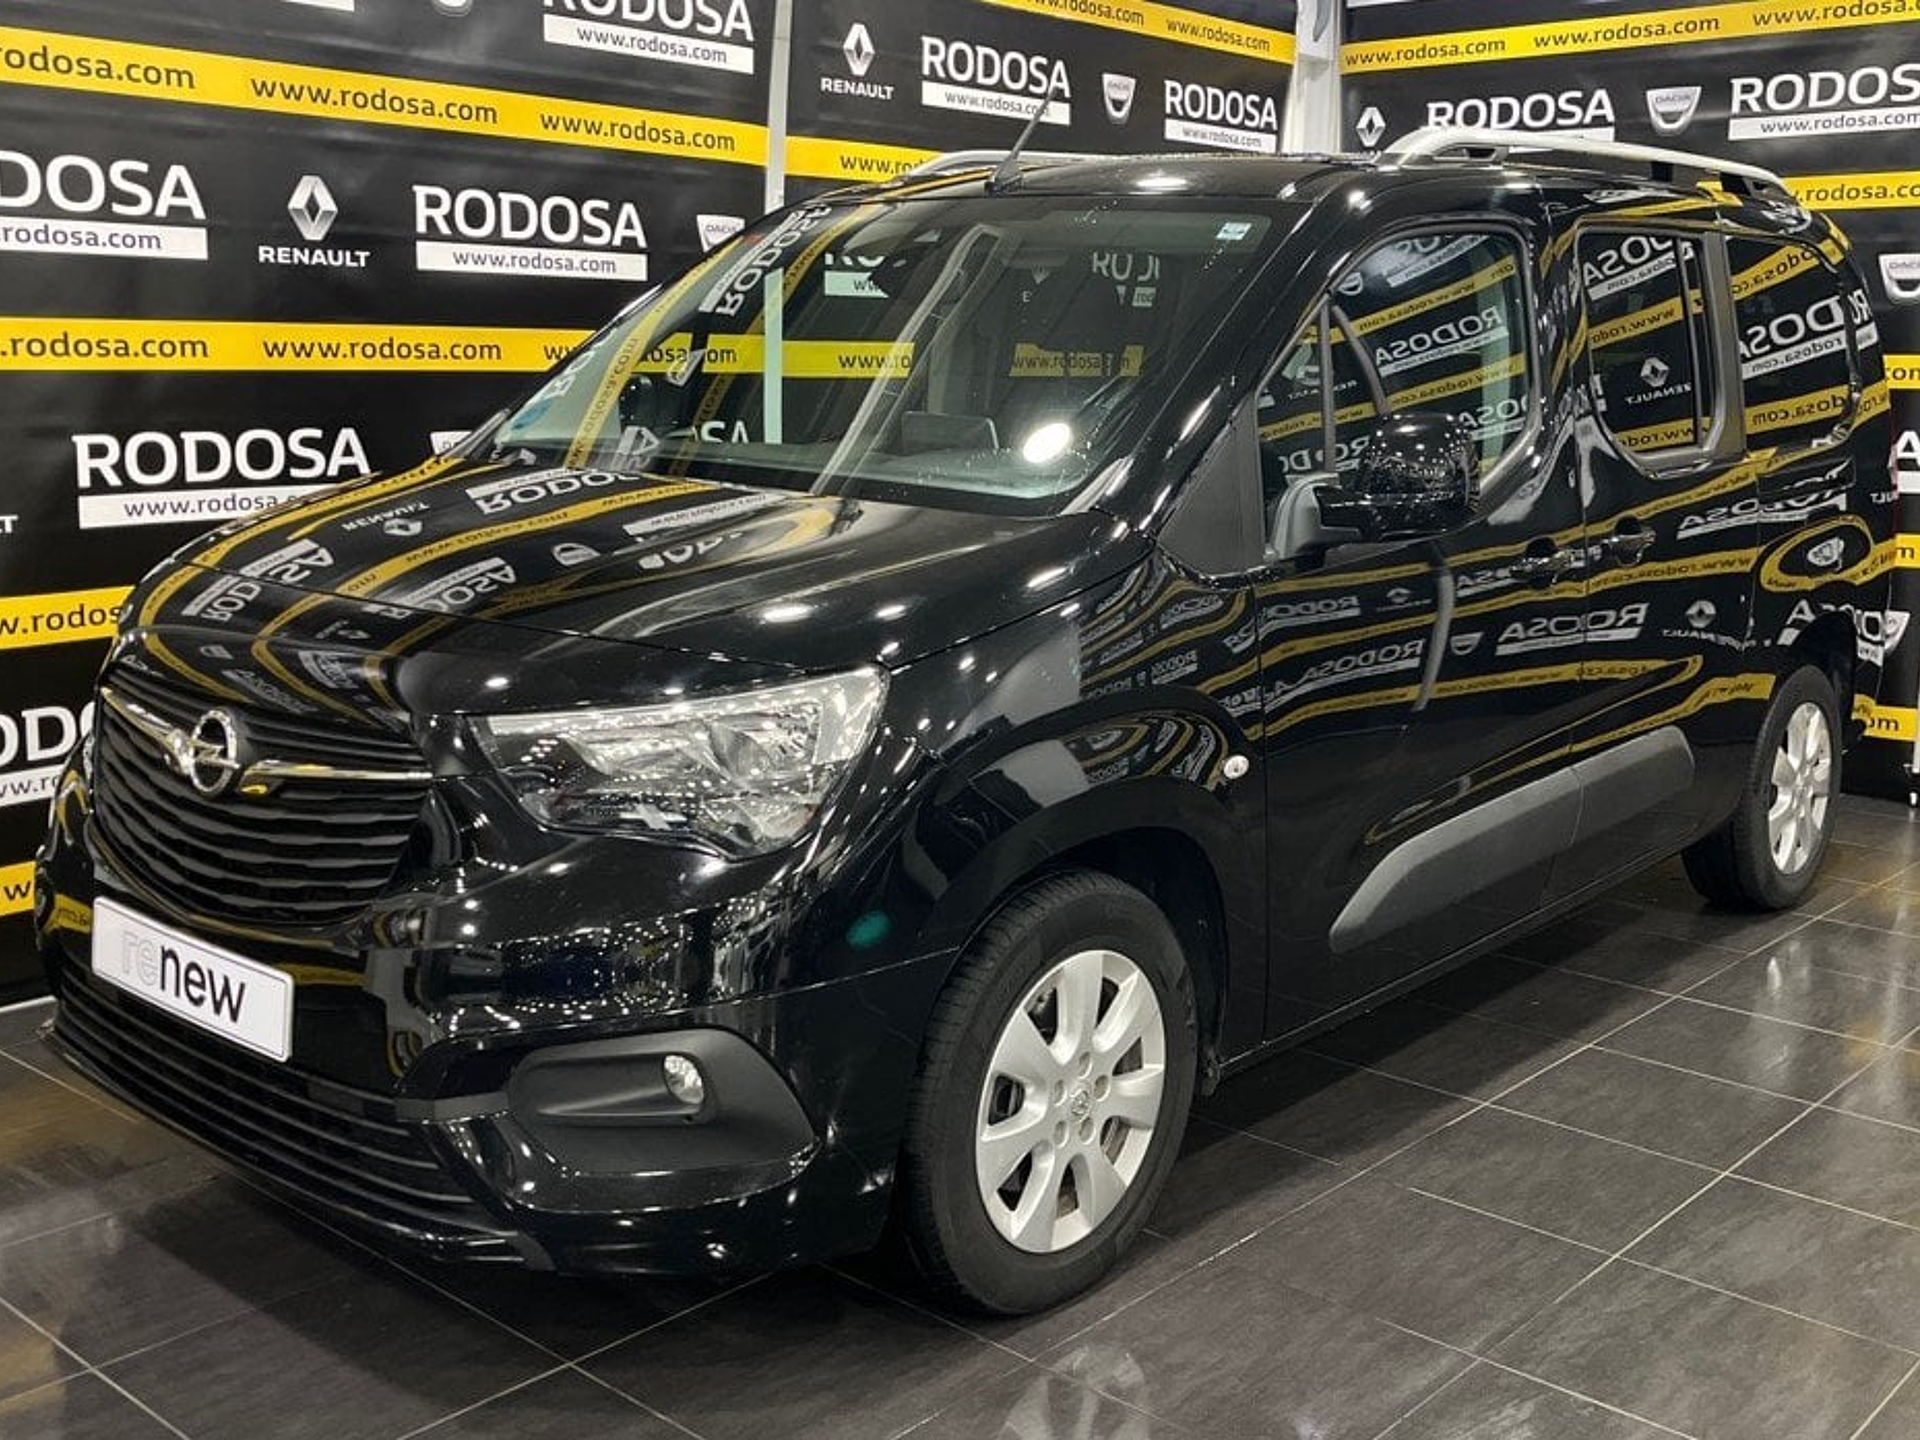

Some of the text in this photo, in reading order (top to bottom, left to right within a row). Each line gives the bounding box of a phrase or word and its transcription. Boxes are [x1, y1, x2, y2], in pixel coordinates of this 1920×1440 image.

[577, 27, 728, 63] www.rodosa.com
[1167, 16, 1271, 51] www.rodosa.com
[1534, 14, 1720, 49] www.rodosa.com
[0, 45, 196, 89] odosa.com
[921, 35, 1072, 98] RODOSA
[1345, 37, 1507, 67] www.rodosa.com
[251, 78, 498, 124] www.rodosa.com
[820, 77, 895, 100] RENAULT
[1164, 79, 1278, 131] RODOSA
[1427, 88, 1616, 129] RODOSA
[540, 111, 736, 152] www.rodosa.com
[412, 185, 648, 249] RODOSA
[258, 245, 372, 268] RENAULT
[452, 249, 617, 274] www.rodosa.com
[263, 336, 502, 361] www.rodosa.com
[71, 427, 371, 489] RODOSA
